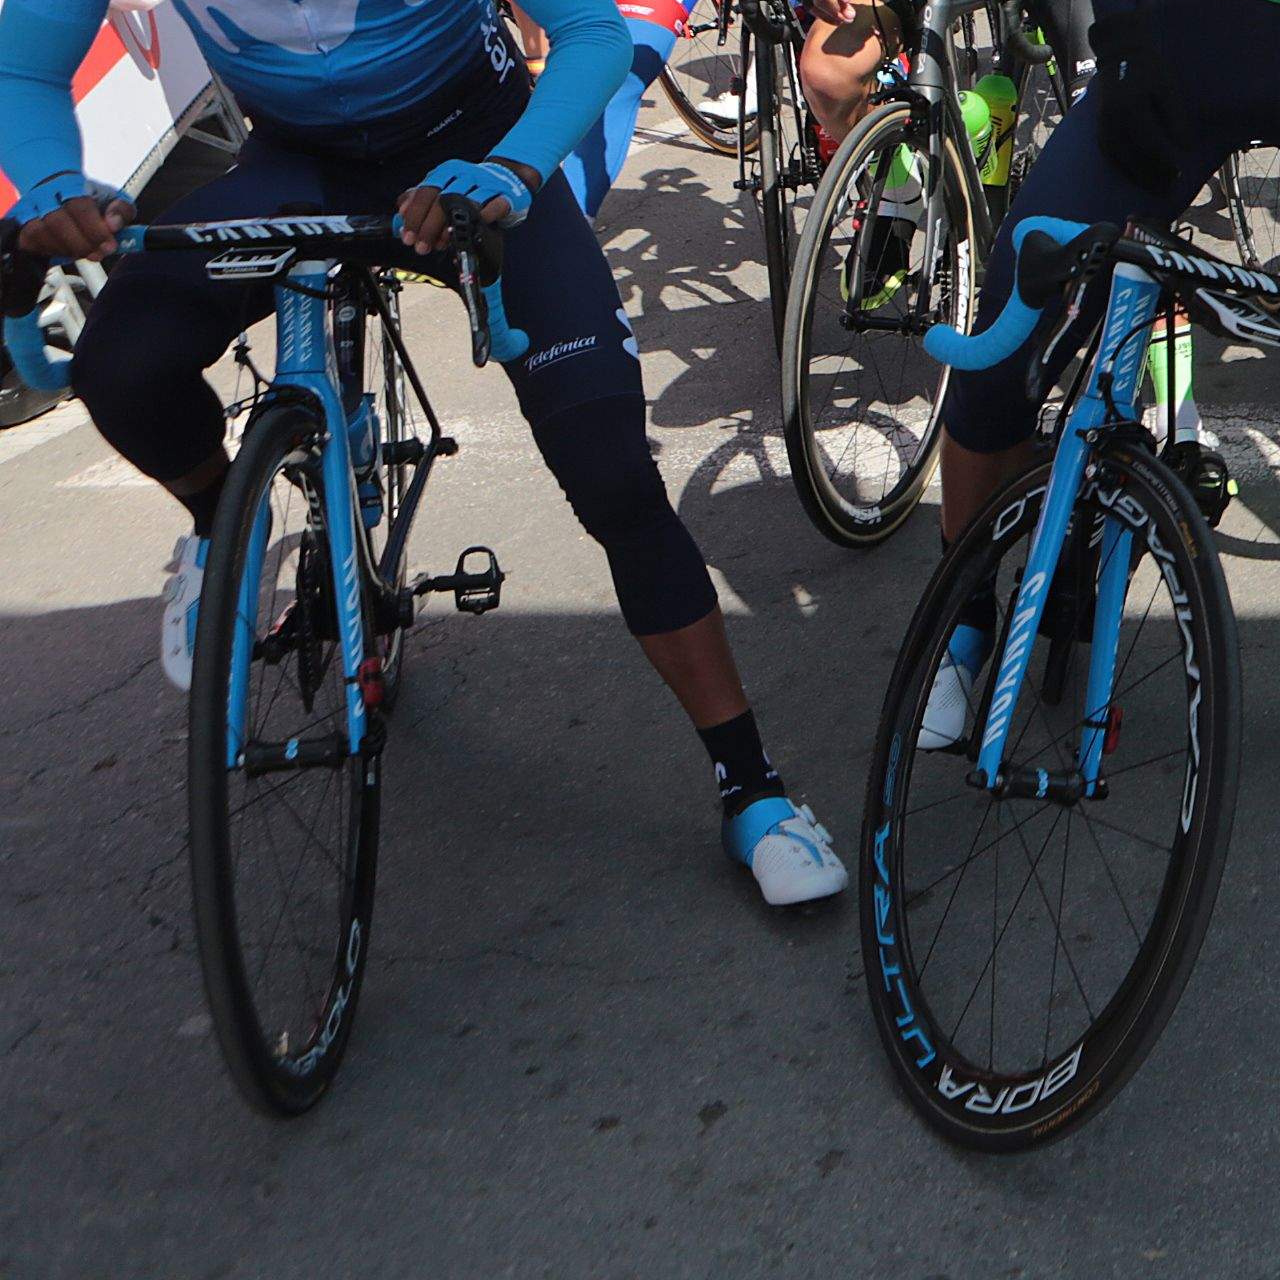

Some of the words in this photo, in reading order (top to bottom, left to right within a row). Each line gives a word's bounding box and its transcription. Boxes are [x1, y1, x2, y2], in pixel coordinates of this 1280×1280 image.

[1145, 244, 1279, 294] CANYON
[525, 334, 598, 372] Telefónica
[982, 570, 1047, 746] CANYON
[873, 819, 937, 1071] ULTRA
[934, 1042, 1084, 1116] BORA
